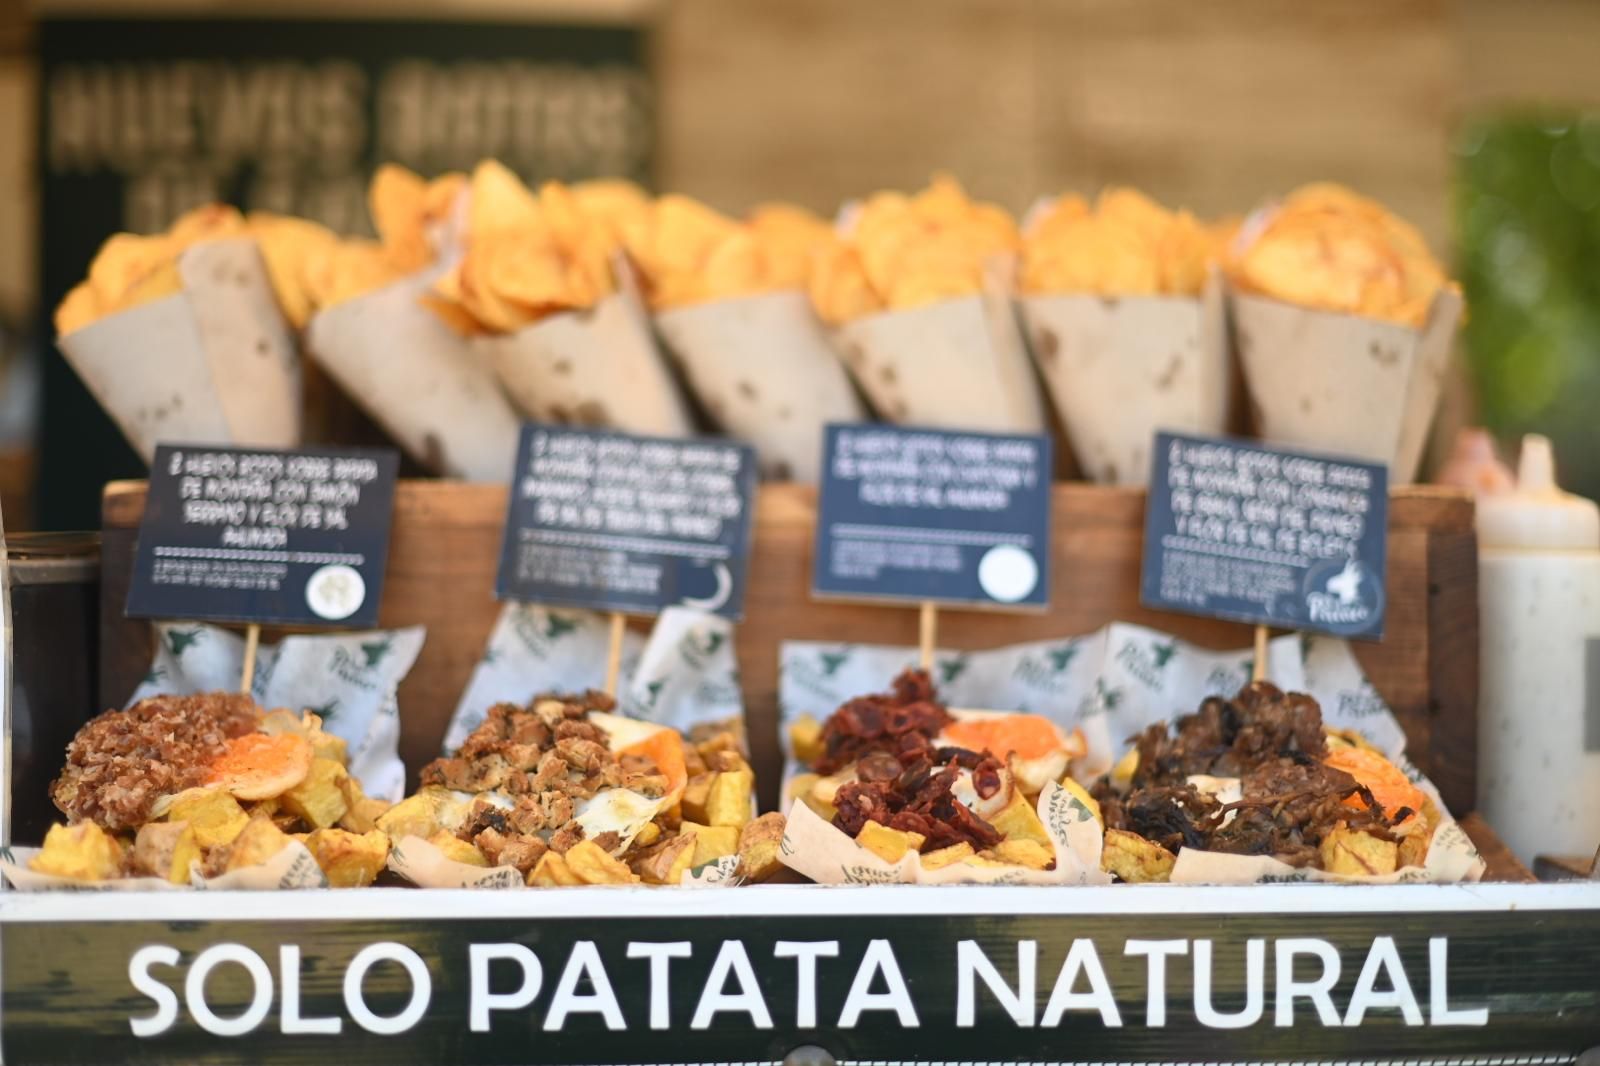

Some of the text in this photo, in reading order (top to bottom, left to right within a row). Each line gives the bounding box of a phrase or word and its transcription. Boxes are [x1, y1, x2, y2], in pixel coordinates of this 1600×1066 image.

[129, 937, 1488, 1035] SOLO PATATA NATURAL
